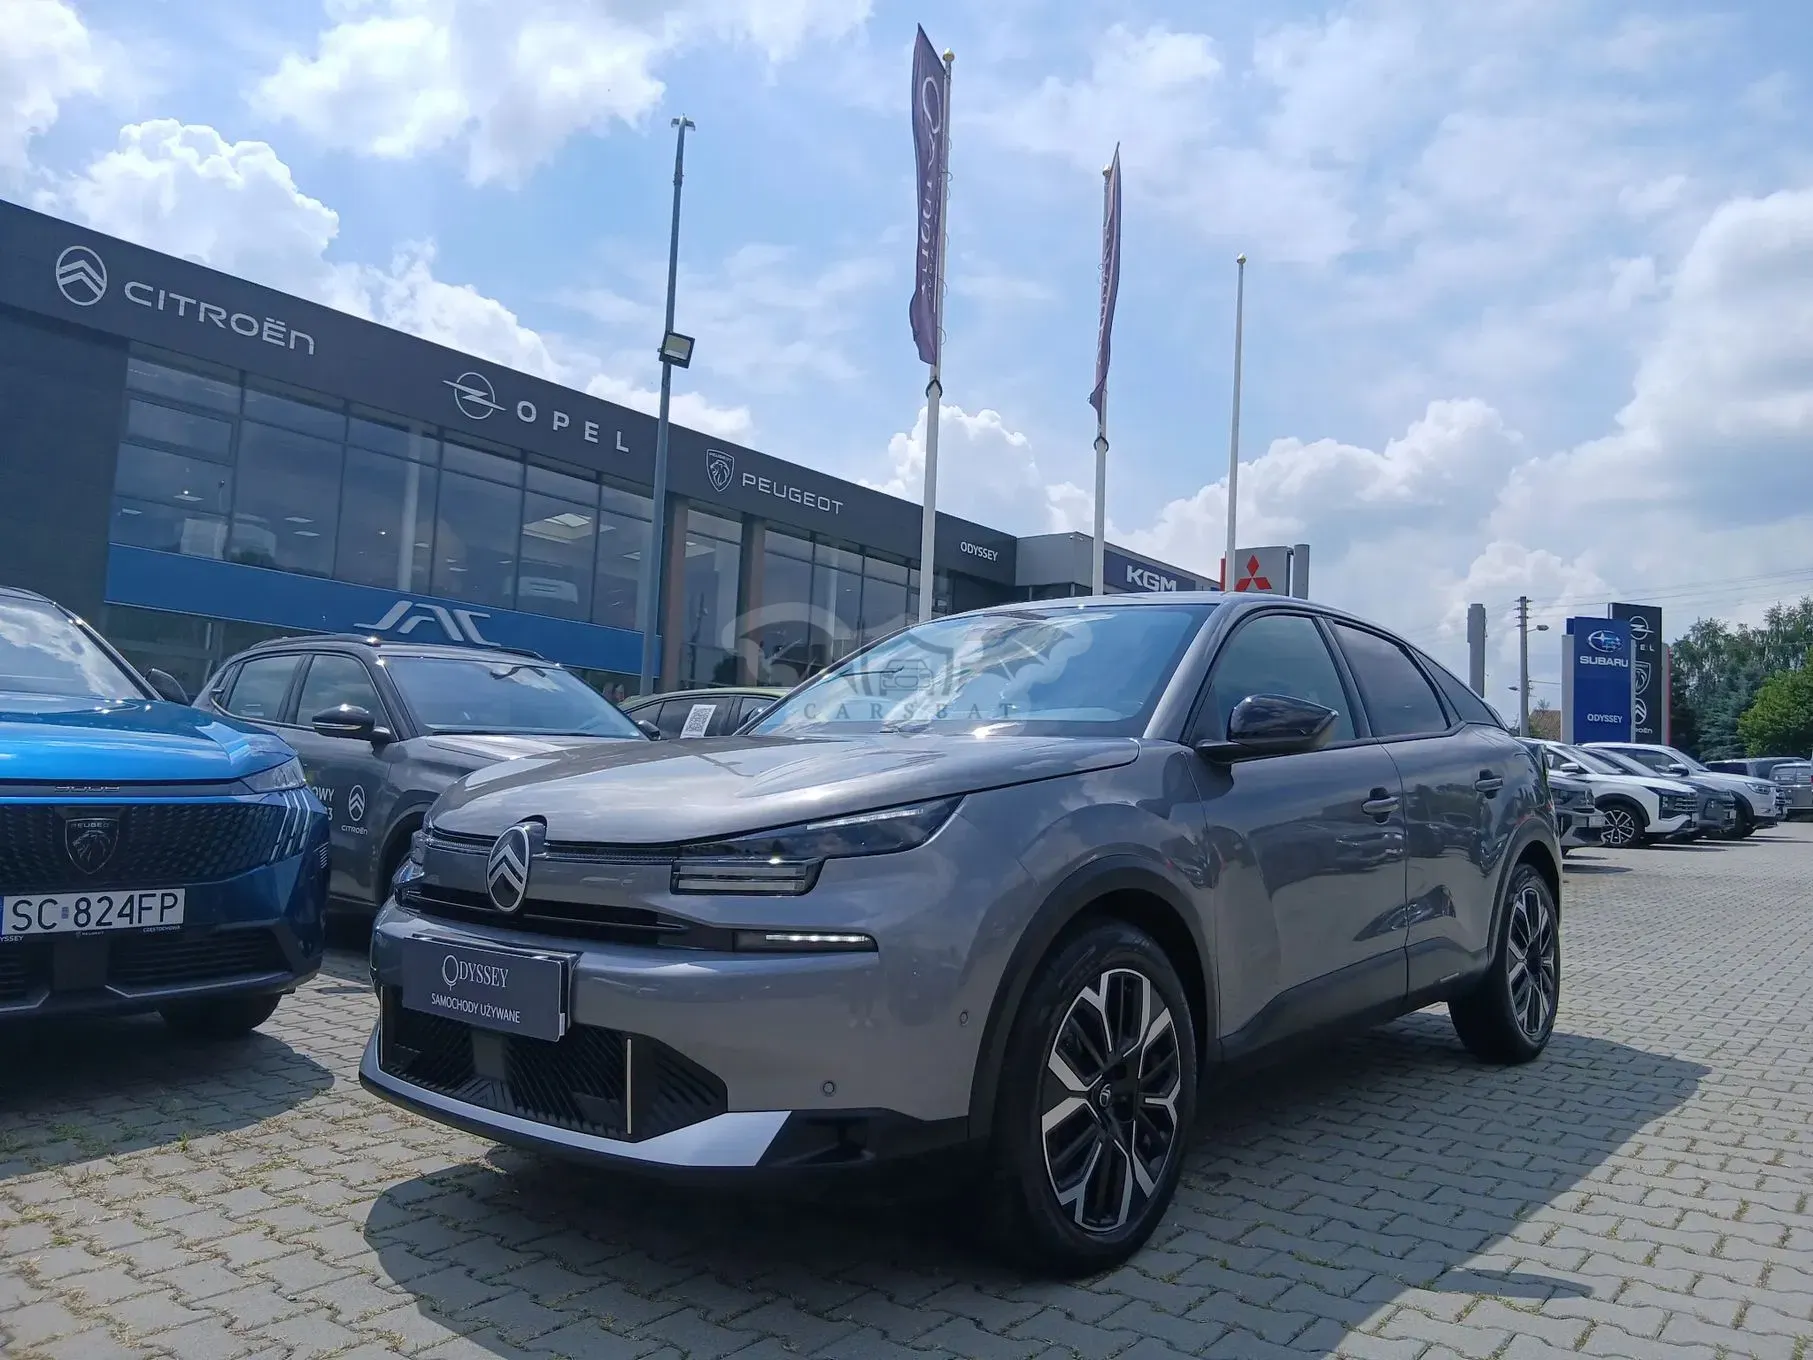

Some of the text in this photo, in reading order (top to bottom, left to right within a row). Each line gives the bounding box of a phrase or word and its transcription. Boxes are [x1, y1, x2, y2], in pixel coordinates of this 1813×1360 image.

[517, 400, 630, 453] OPEL
[742, 472, 844, 515] PEUGEOT
[960, 541, 998, 563] ODYSSEY
[1126, 565, 1177, 592] KGM
[353, 600, 502, 647] JAC
[1579, 655, 1629, 668] SUBARU
[1586, 713, 1623, 724] ODYSSEY
[11, 892, 179, 932] SC 824FP
[441, 954, 510, 992] ODYSSEY
[431, 992, 521, 1025] SAMOCHODY UŻYWANE
